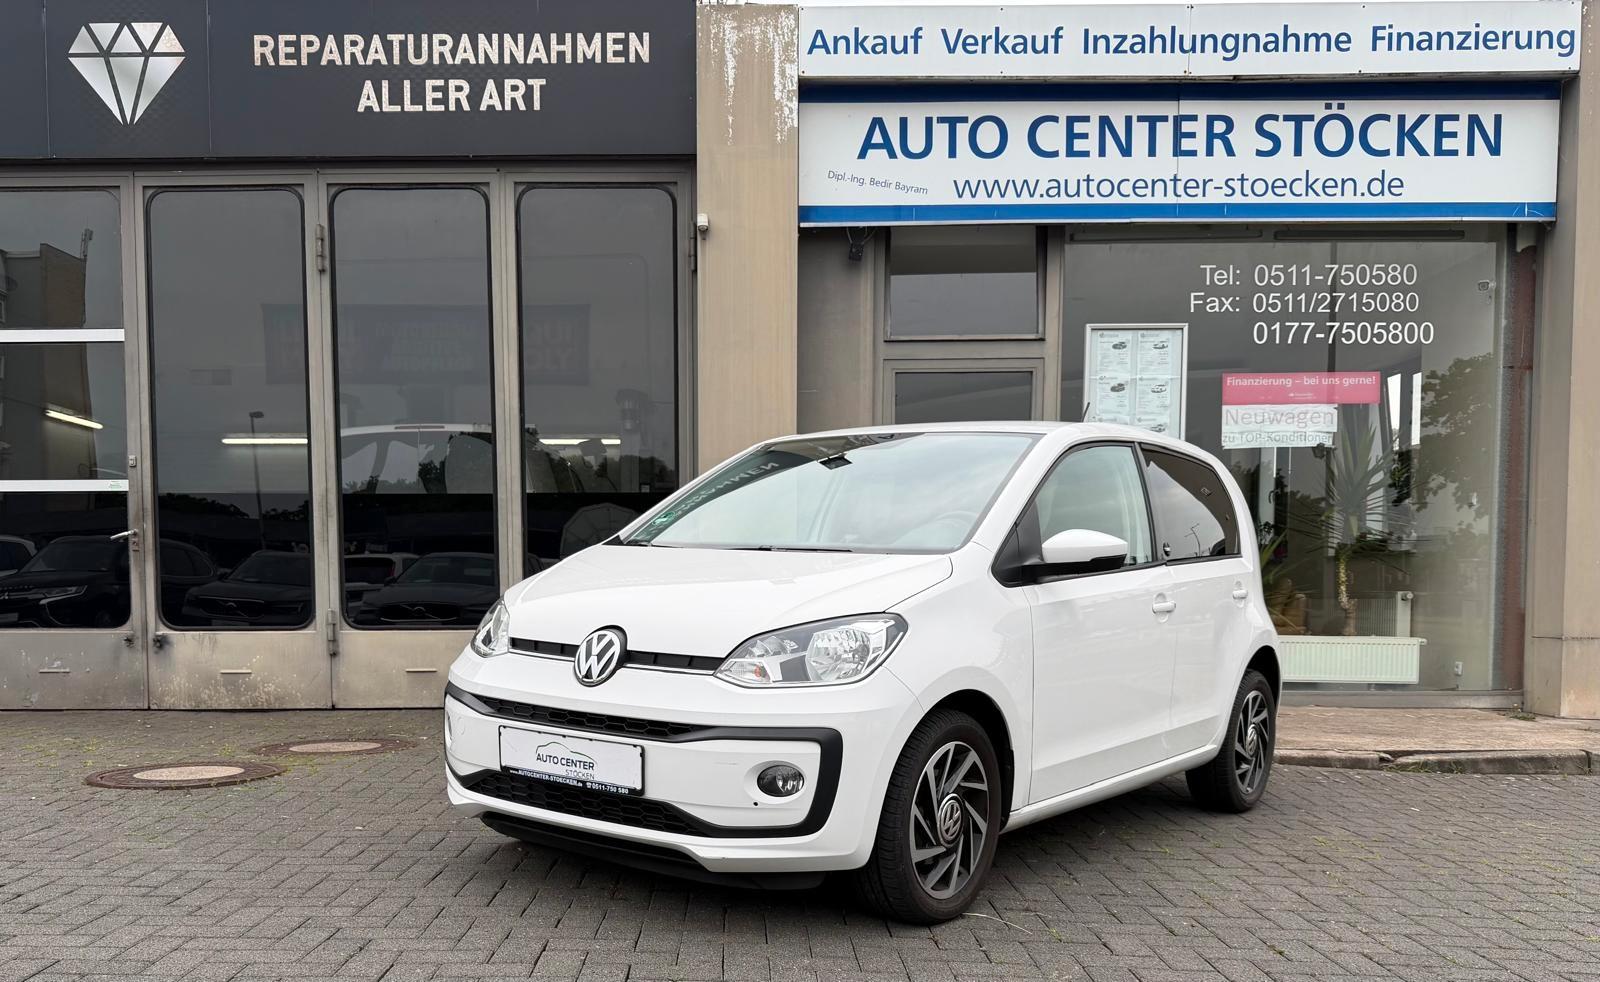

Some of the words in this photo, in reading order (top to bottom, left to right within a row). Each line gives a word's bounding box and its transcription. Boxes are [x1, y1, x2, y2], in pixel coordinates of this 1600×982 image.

[253, 32, 650, 66] REPARATURANNAHMEN
[806, 27, 923, 55] Ankauf
[940, 26, 1063, 54] Verkauf
[1082, 25, 1352, 62] Inzahlungnahme
[1371, 23, 1576, 57] Finanzierung
[357, 79, 471, 112] ALLER
[479, 78, 546, 111] ART
[856, 115, 1009, 160] AUTO
[1026, 114, 1237, 159] CENTER
[1254, 102, 1503, 158] STÖCKEN
[827, 170, 867, 187] Dipl.-Ing.
[869, 177, 893, 189] Bedir
[894, 181, 928, 195] Bayram
[953, 169, 1405, 199] www.autocenter-stoecken.de
[1200, 264, 1241, 286] Tel:
[1254, 264, 1418, 286] 0511-750580
[1190, 292, 1240, 313] Fax:
[1252, 292, 1420, 313] 0511/2715080
[1253, 322, 1435, 345] 0177-7505800
[1227, 376, 1292, 387] Finanzierung
[1303, 375, 1319, 385] bei
[1322, 376, 1340, 385] uns
[1342, 375, 1376, 387] gerne!
[1225, 409, 1334, 428] Neuwagen
[536, 752, 560, 766] AUTO
[560, 757, 595, 771] CENTER
[565, 769, 595, 780] STÖCKEN
